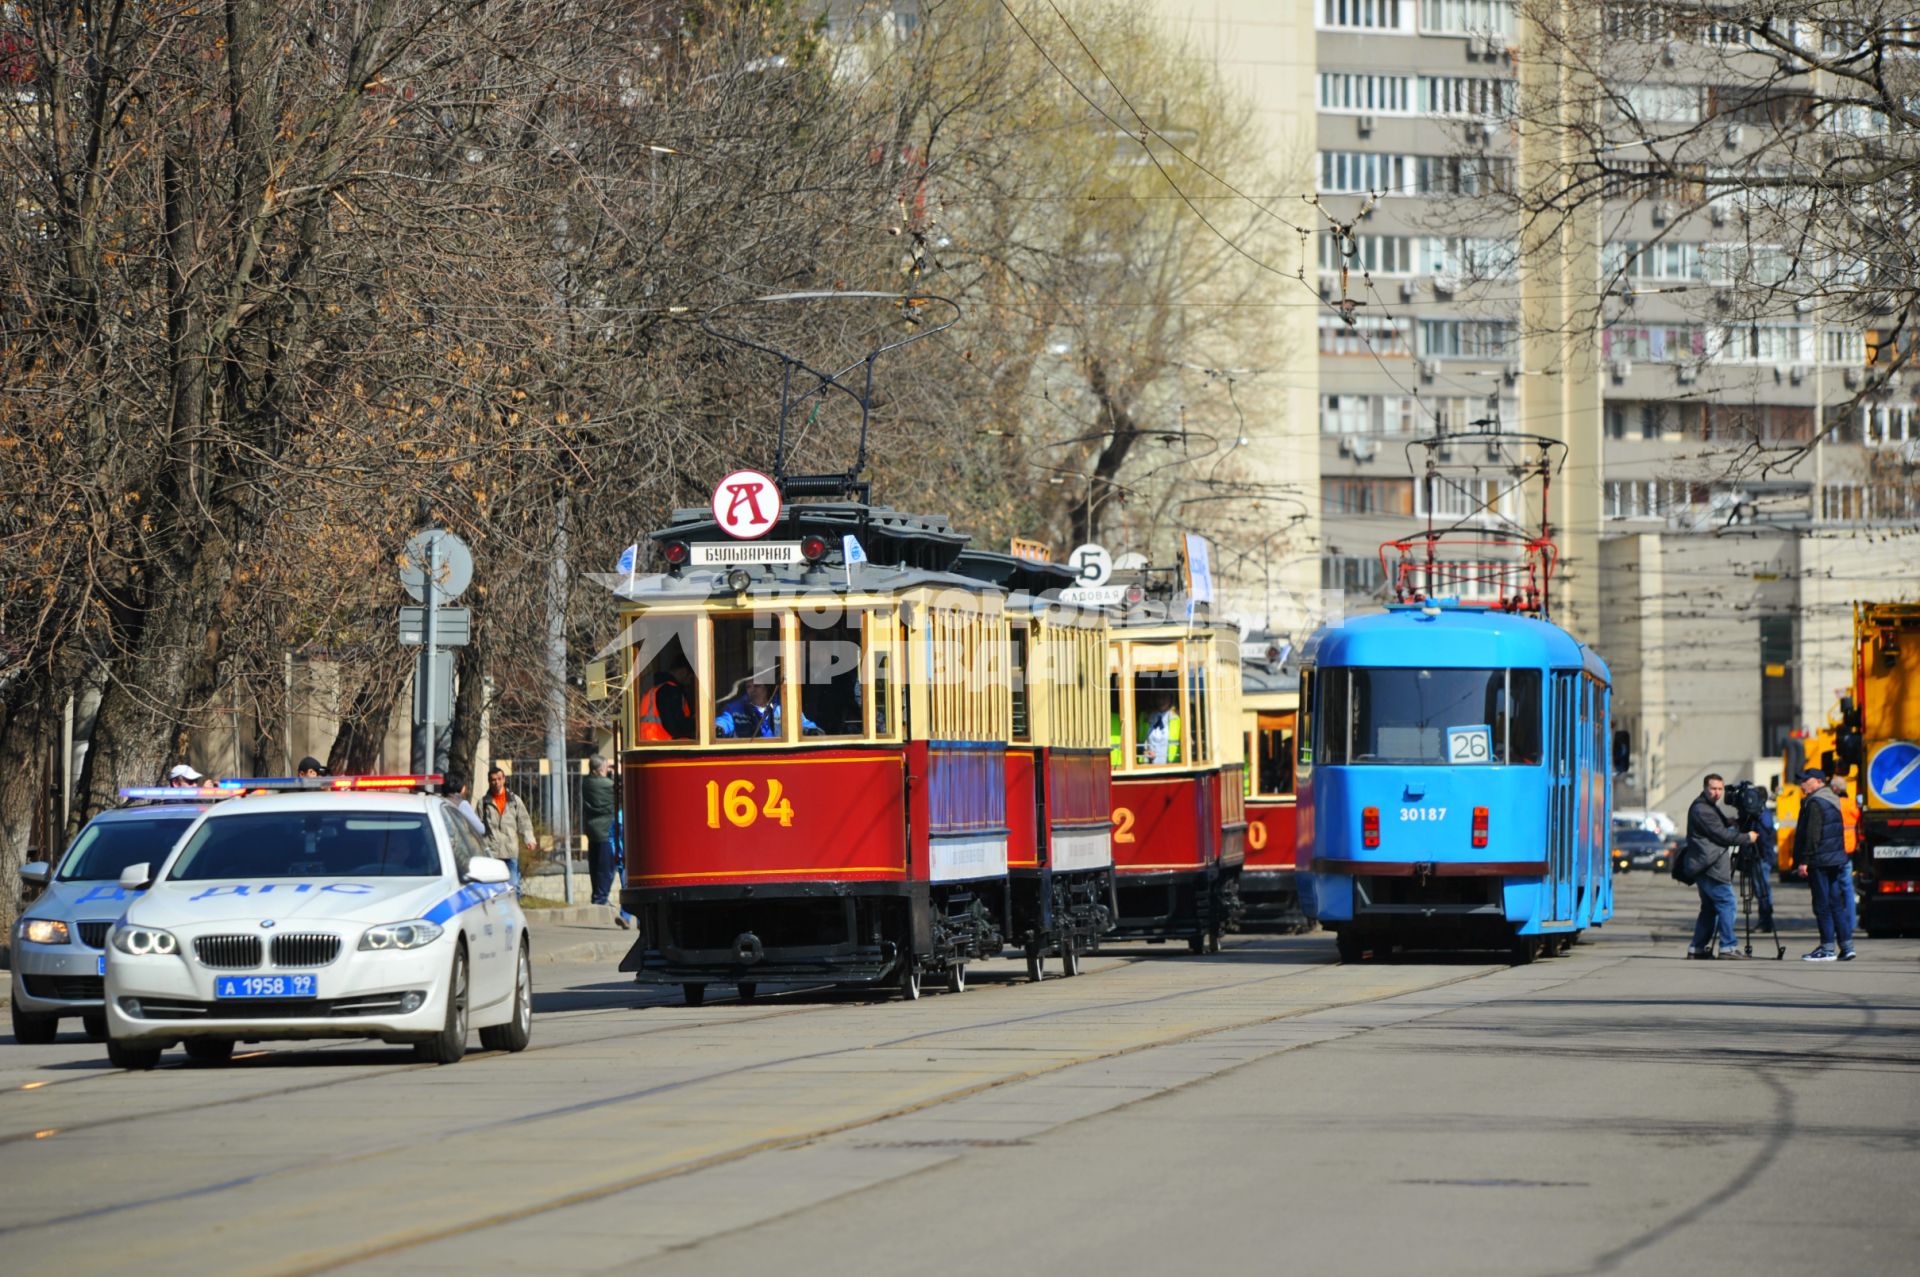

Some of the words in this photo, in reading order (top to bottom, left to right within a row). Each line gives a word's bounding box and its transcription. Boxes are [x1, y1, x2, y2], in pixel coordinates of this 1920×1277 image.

[726, 483, 769, 526] А
[705, 546, 791, 562] БУЛЬВАРНАЯ
[1080, 551, 1102, 581] 5
[1062, 590, 1119, 603] САДОВАЯ
[1453, 734, 1486, 759] 26
[706, 779, 795, 829] 164
[1400, 808, 1447, 821] 30187
[1112, 807, 1136, 844] 2
[188, 883, 375, 901] ДПС
[225, 981, 236, 995] А
[242, 978, 285, 994] 1958
[293, 976, 311, 991] 99
